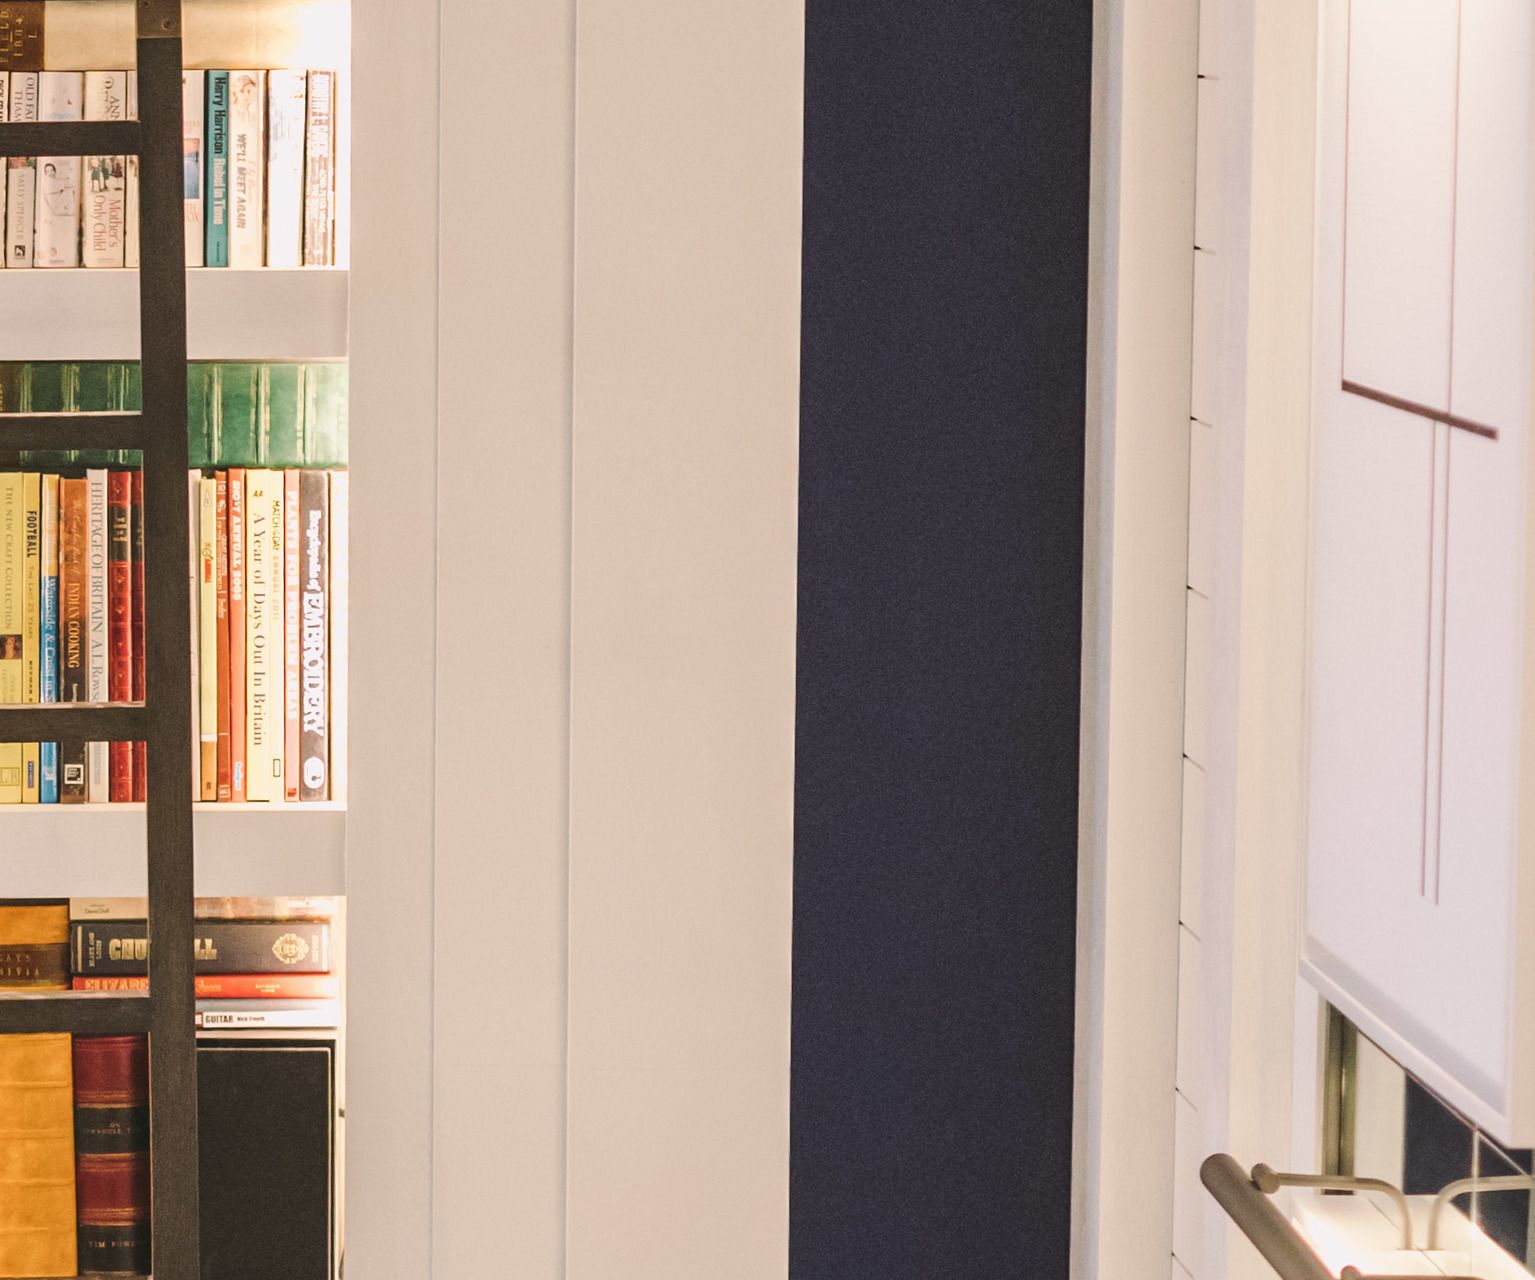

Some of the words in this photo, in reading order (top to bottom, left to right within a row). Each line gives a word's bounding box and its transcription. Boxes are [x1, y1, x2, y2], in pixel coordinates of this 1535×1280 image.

[94, 195, 105, 220] Only
[108, 200, 121, 247] Mother's
[94, 222, 106, 251] Child
[5, 487, 13, 505] THE
[5, 509, 13, 532] NEW
[27, 510, 37, 558] FOOTBALL
[92, 482, 103, 550] HERITAGE
[5, 534, 14, 565] CRAFT
[93, 554, 103, 572] OF
[5, 567, 14, 630] COLLECTION
[68, 583, 80, 620] INDIAN
[93, 576, 103, 633] BRITAIN
[68, 621, 80, 668] COOKING
